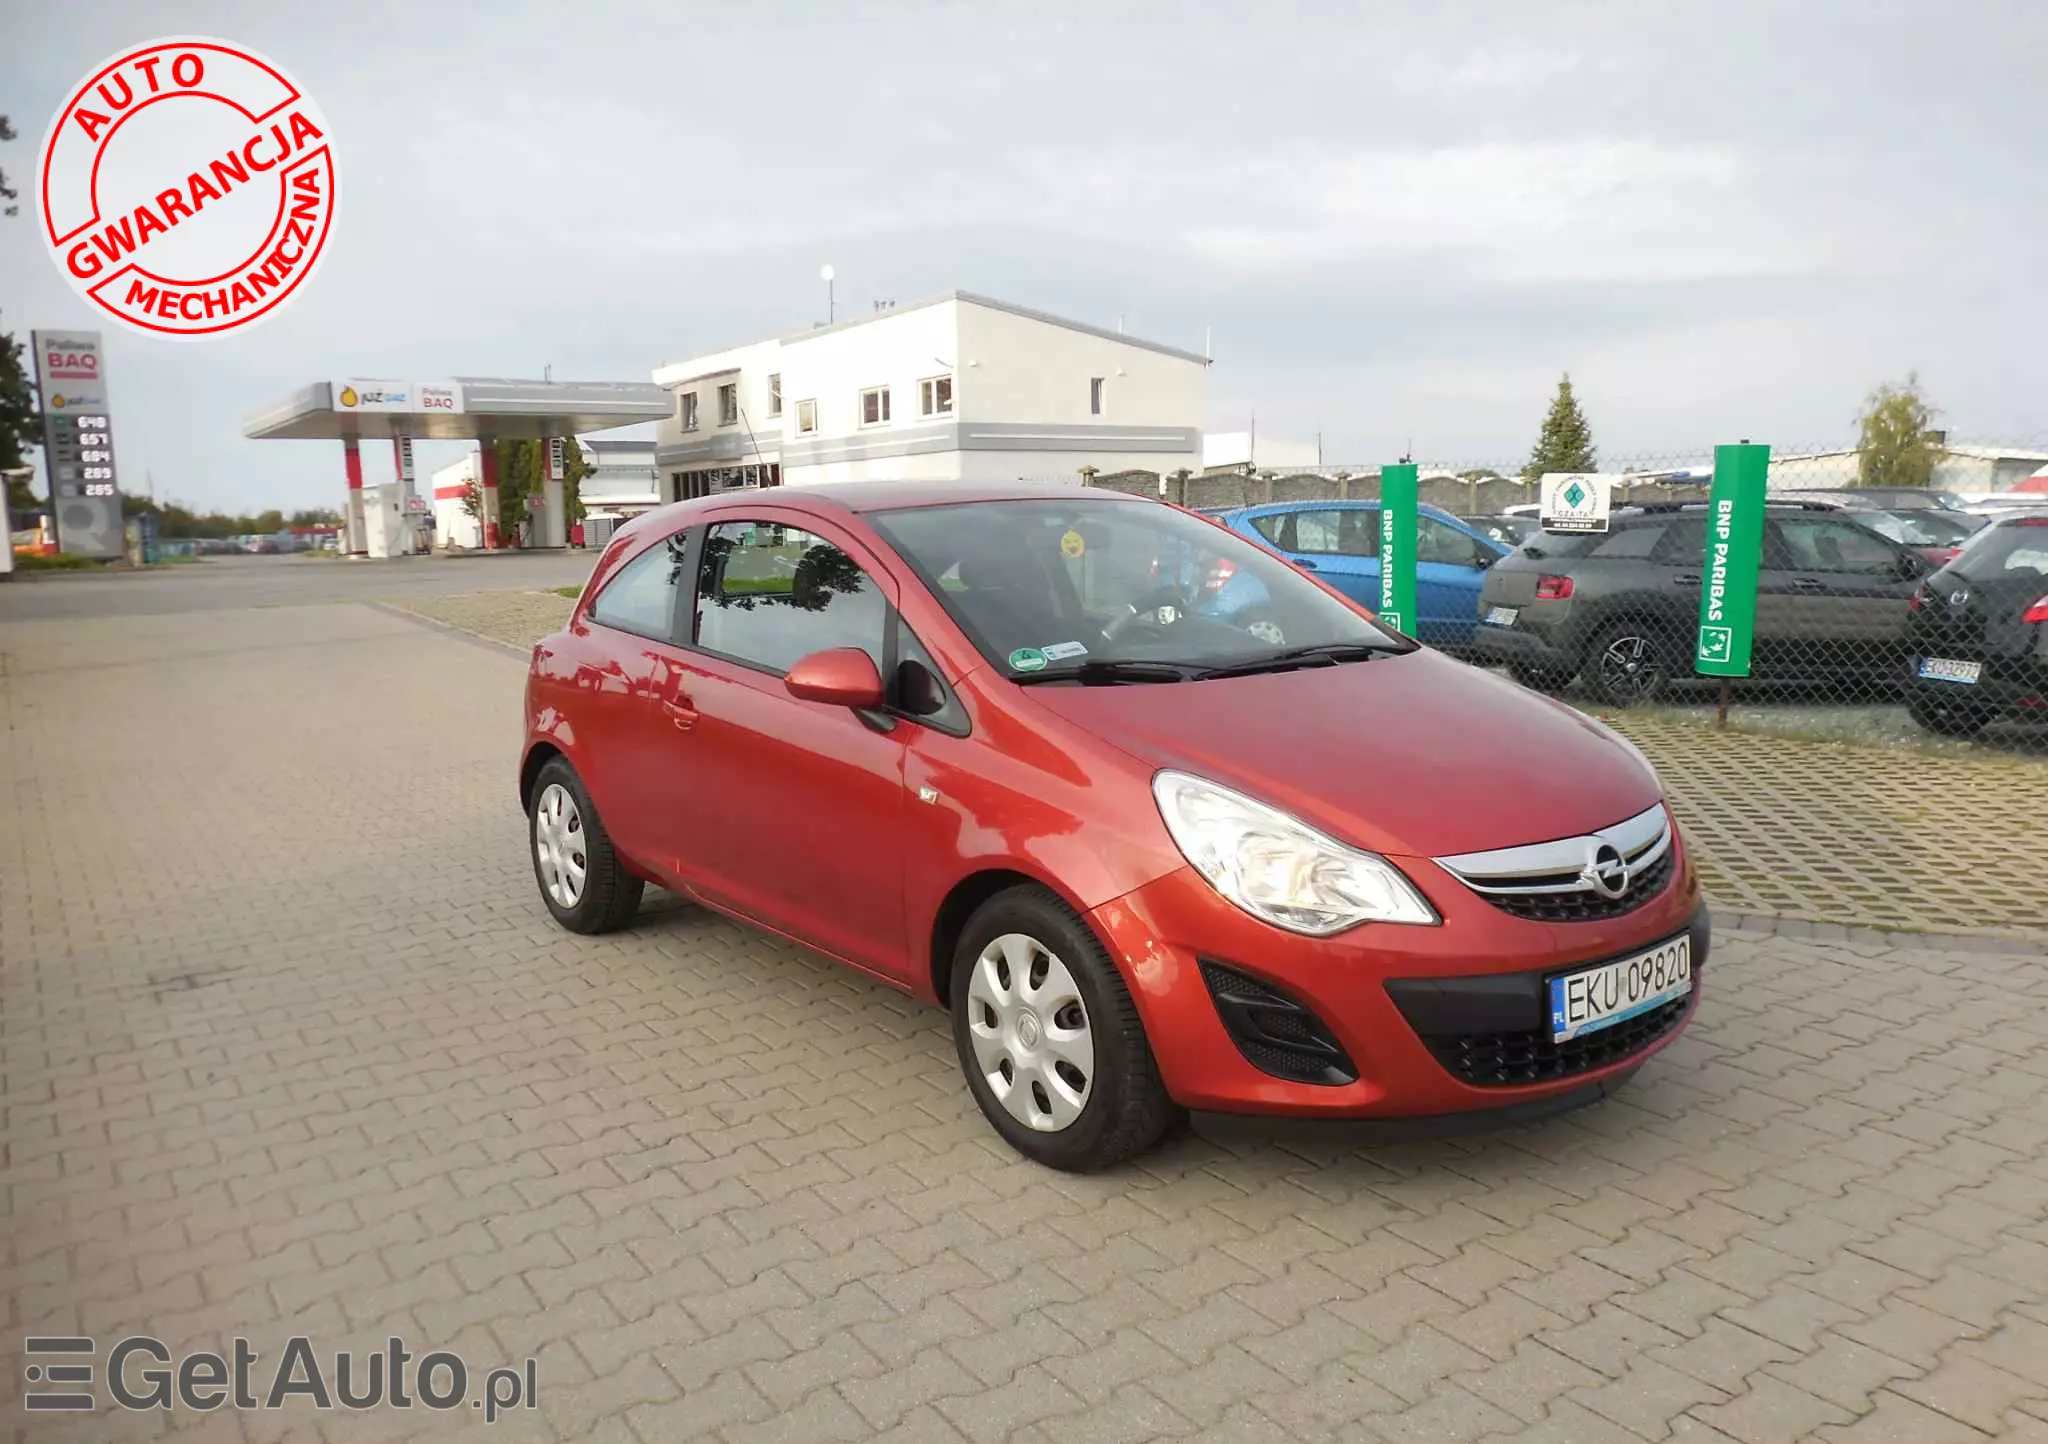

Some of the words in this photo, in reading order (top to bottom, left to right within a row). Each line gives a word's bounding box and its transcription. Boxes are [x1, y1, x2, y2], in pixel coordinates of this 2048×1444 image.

[48, 352, 97, 370] BAQ
[424, 397, 453, 409] BAQ
[1383, 509, 1393, 542] BNP
[1716, 500, 1733, 540] BNP
[1382, 544, 1393, 608] PARIBAS
[1708, 543, 1729, 621] PARIBAS
[1568, 967, 1619, 1023] EKU
[1627, 941, 1688, 1002] 09820
